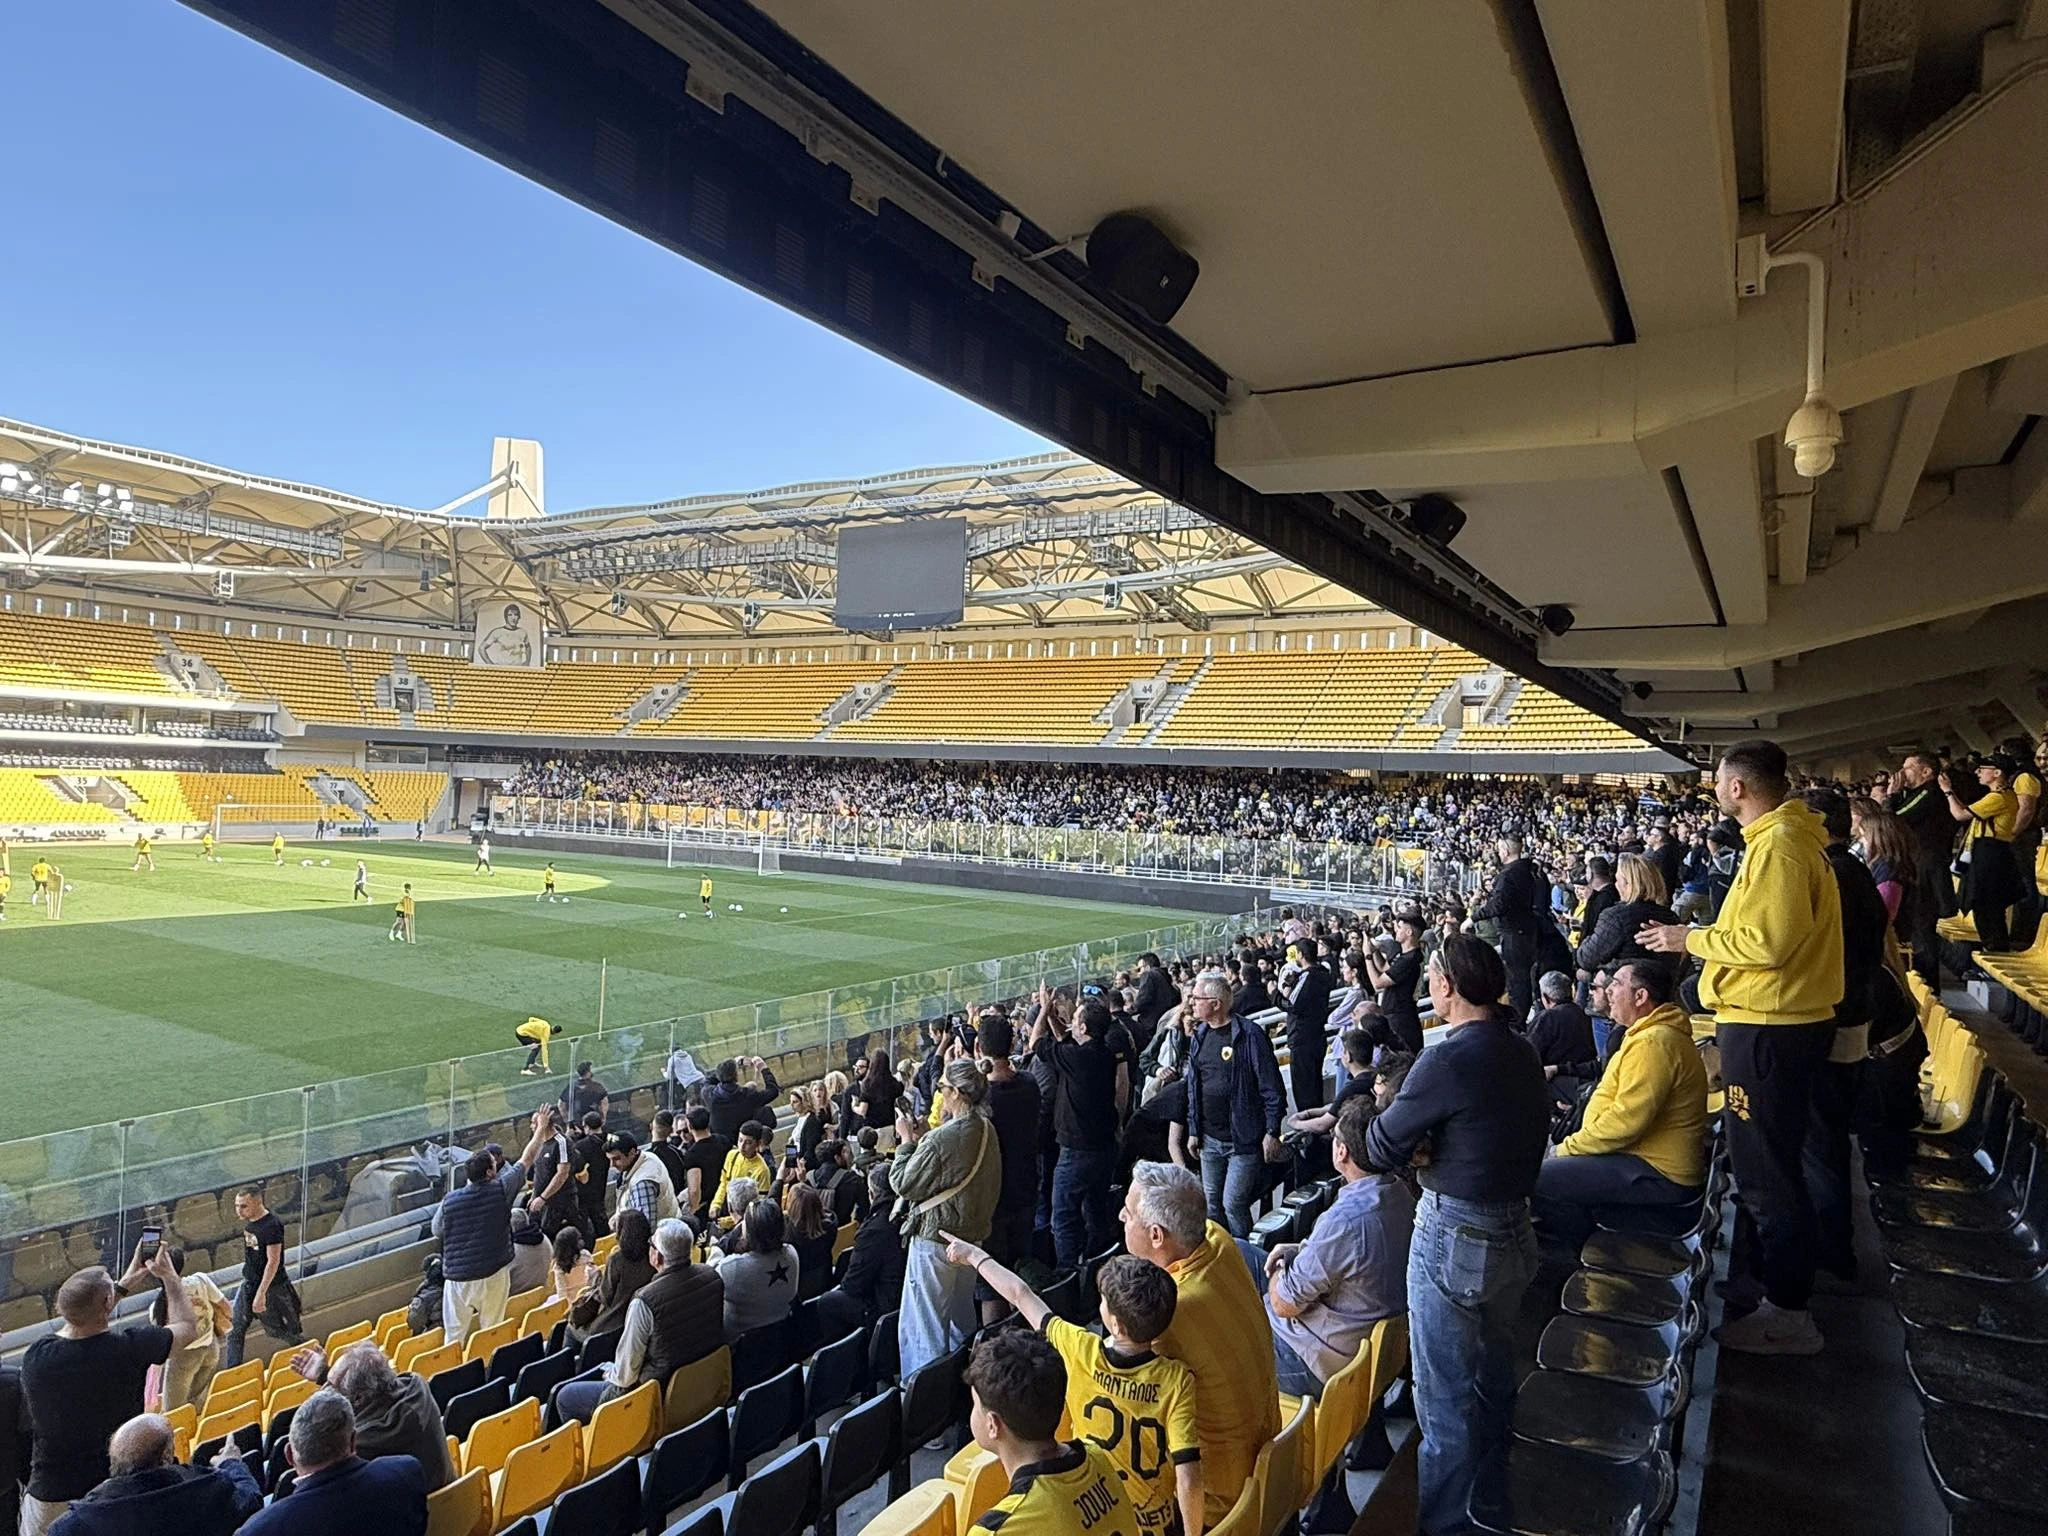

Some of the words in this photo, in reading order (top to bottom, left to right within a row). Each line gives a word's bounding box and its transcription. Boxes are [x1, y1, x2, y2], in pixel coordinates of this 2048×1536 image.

[181, 658, 192, 667] 36
[398, 677, 408, 685] 38
[1473, 680, 1486, 690] 46
[1142, 684, 1152, 694] 44
[77, 777, 87, 785] 35
[1083, 1395, 1168, 1480] 20
